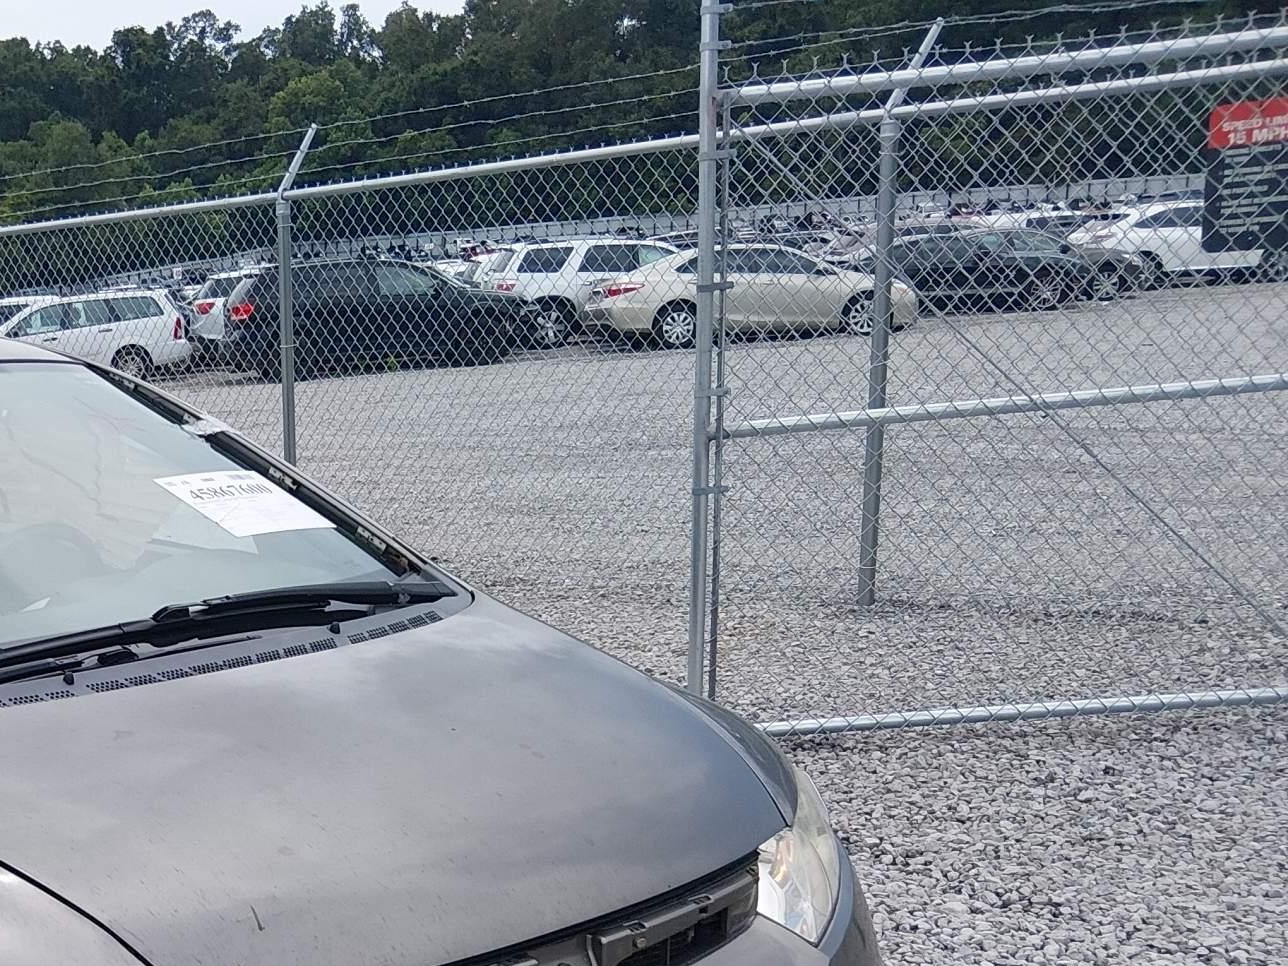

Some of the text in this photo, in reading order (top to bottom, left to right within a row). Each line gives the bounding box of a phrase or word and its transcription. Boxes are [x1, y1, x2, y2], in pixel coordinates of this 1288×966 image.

[1222, 119, 1263, 131] SPEED
[1228, 131, 1248, 145] 15
[189, 483, 273, 500] 45867600
